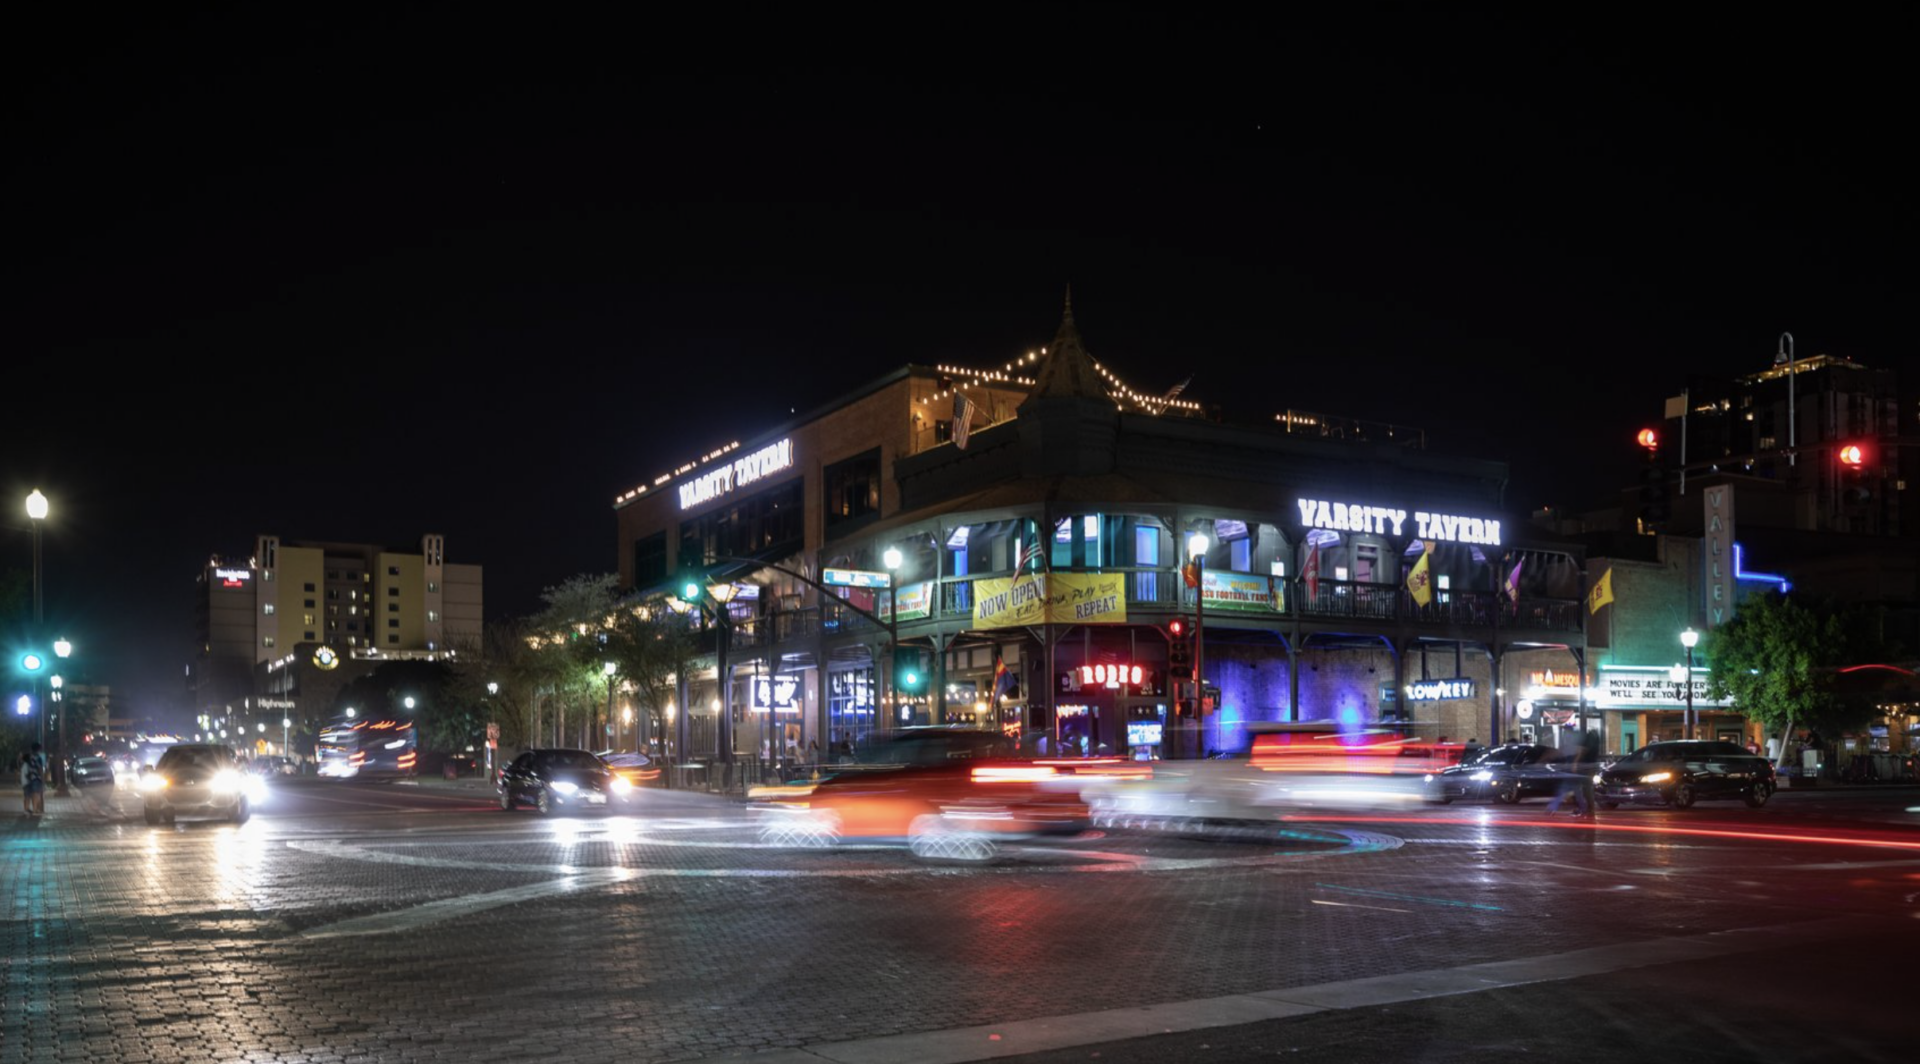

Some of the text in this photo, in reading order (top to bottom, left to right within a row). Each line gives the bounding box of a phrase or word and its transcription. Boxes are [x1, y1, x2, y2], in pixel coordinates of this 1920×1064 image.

[679, 438, 793, 510] VARSITY TAVERN
[1298, 498, 1501, 546] VARSITY TAVERN
[1710, 492, 1723, 623] VALLEY
[979, 591, 1008, 619] NOW
[1072, 586, 1095, 601] PLAY
[1076, 595, 1117, 619] REPEAT
[1553, 673, 1590, 687] MESQUE
[1610, 680, 1640, 688] MOVIES
[1646, 680, 1662, 688] ARE
[1610, 690, 1632, 698] WE'LL
